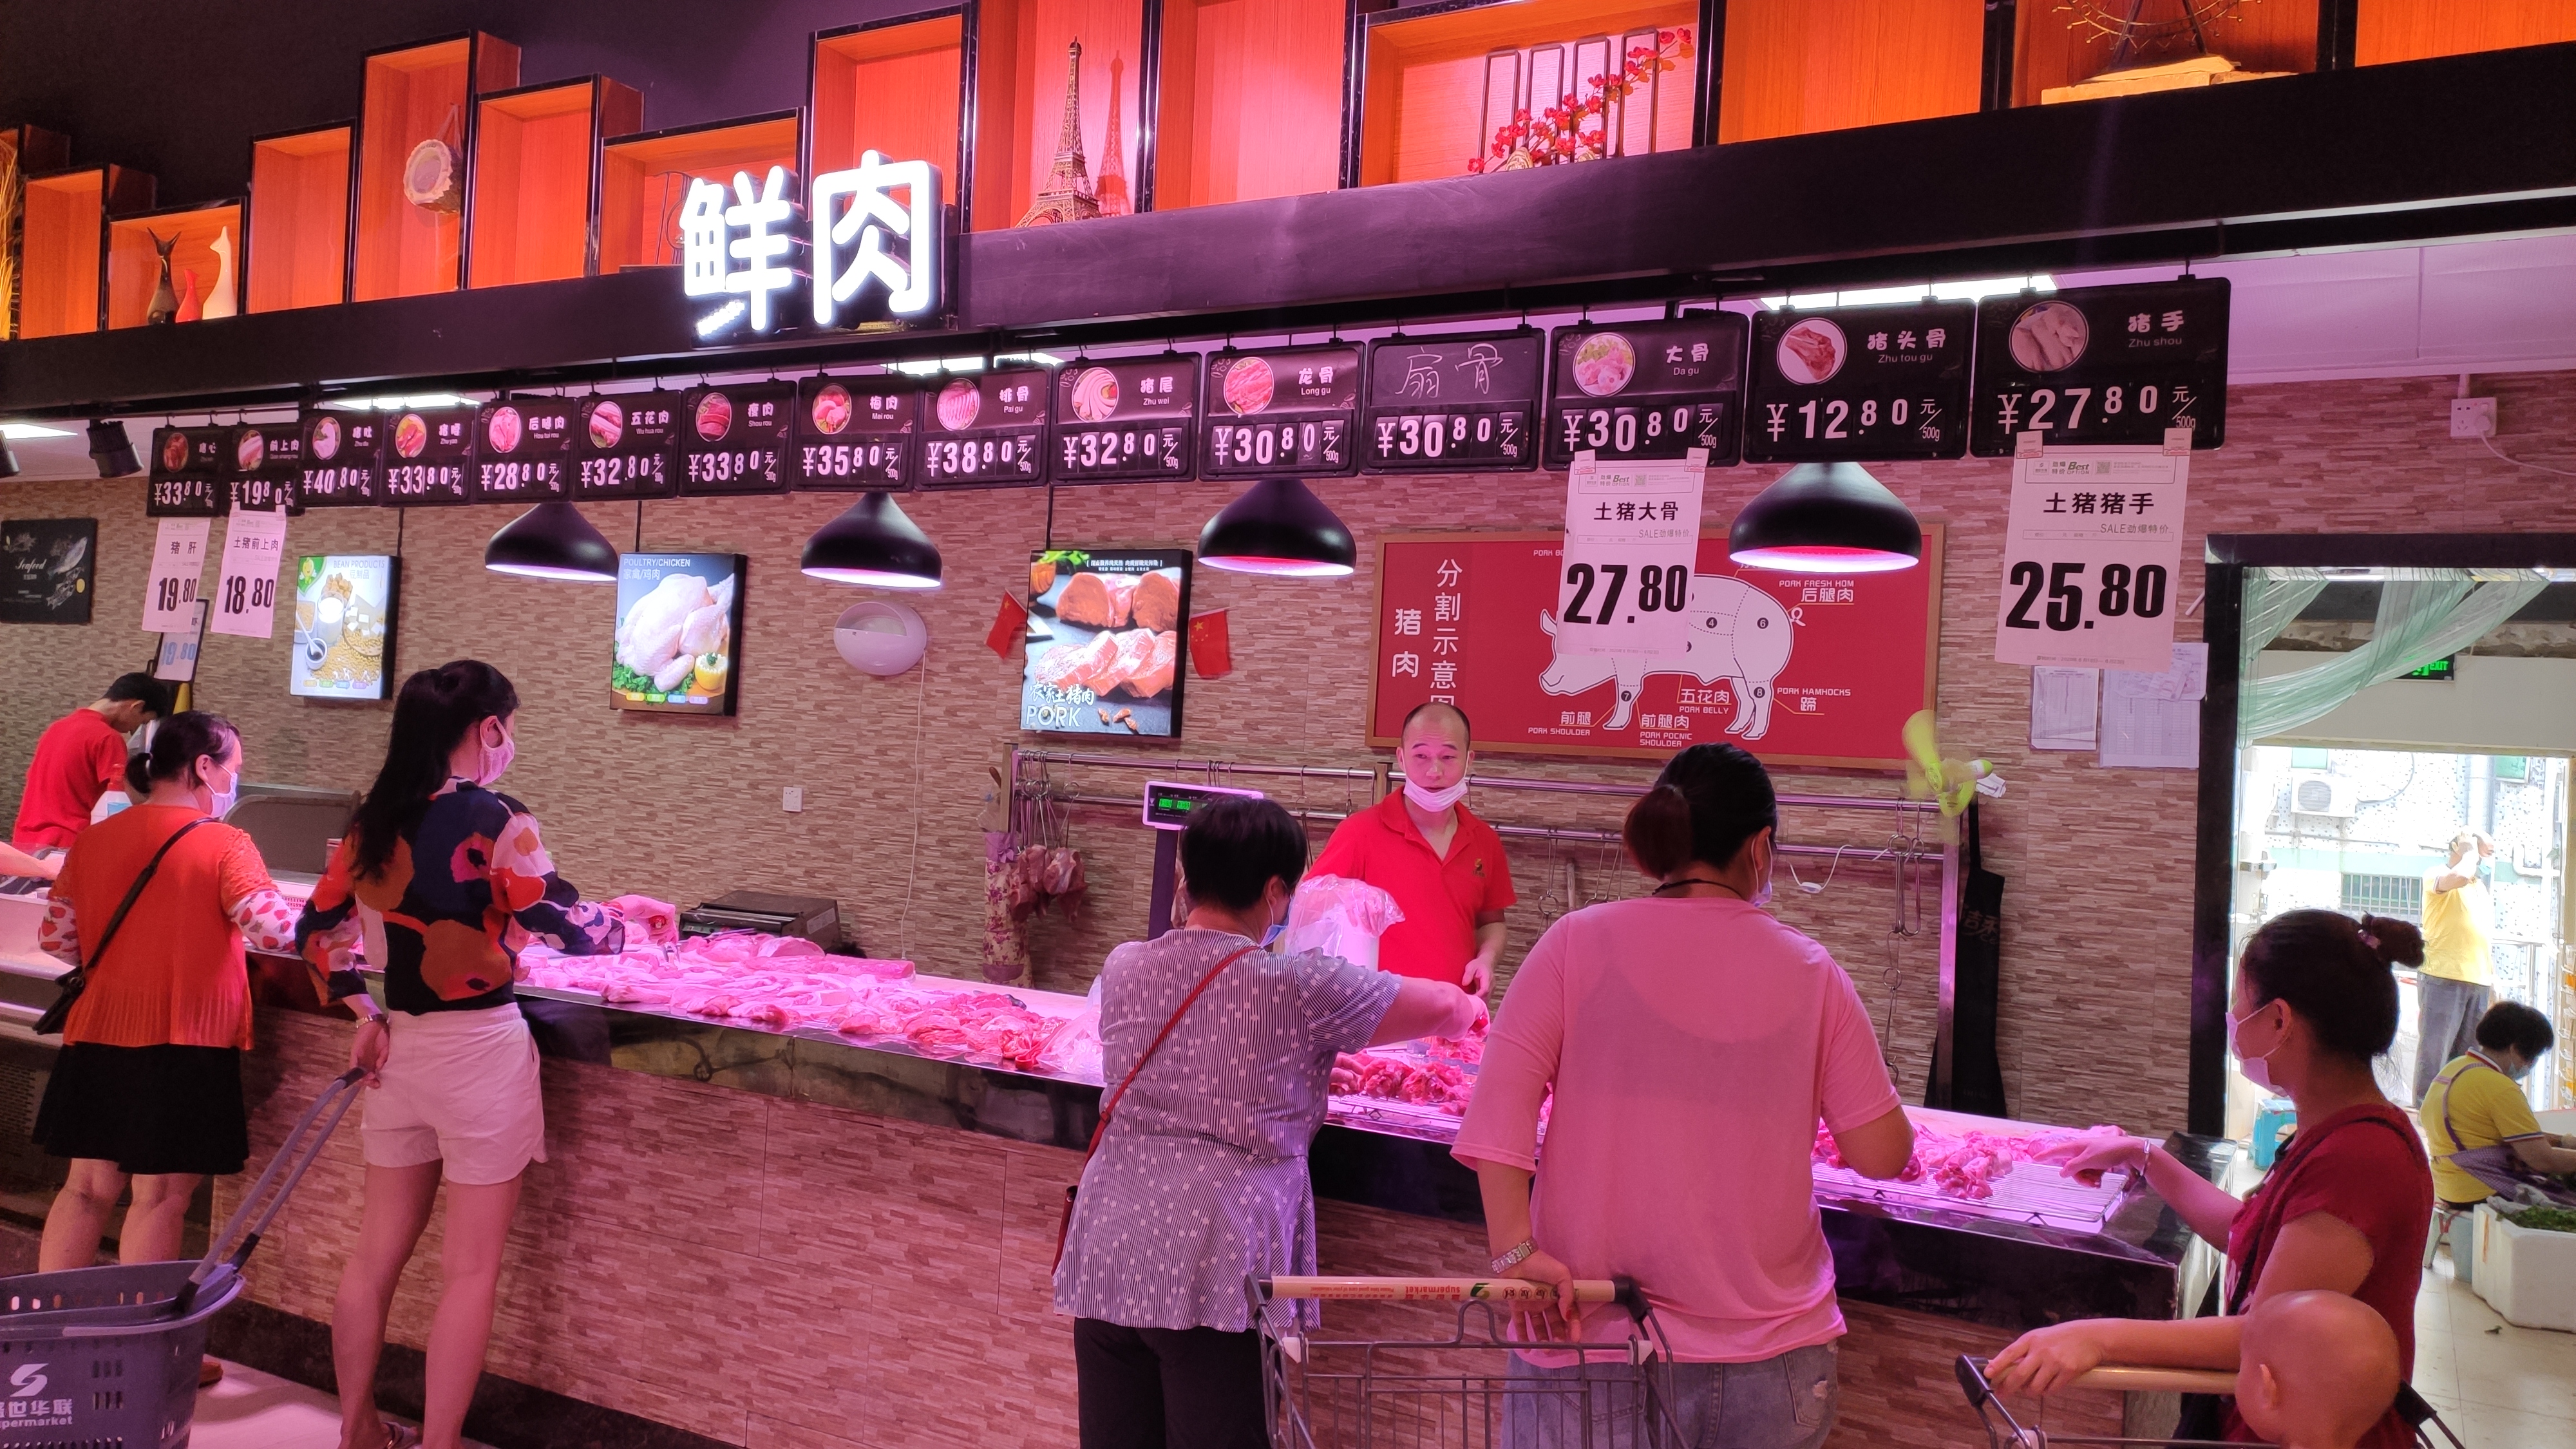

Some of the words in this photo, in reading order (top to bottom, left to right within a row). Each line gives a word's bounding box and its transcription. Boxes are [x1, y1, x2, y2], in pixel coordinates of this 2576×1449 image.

[679, 149, 938, 336] 鲜肉
[2128, 310, 2184, 332] 猪手
[1868, 328, 1946, 351] 猪头骨
[2128, 338, 2150, 348] Zhu
[2154, 337, 2183, 346] shou
[1666, 343, 1709, 364] 大骨
[1878, 354, 1898, 364] Zhu
[1900, 354, 1917, 363] tou
[1920, 355, 1933, 365] gu
[1298, 366, 1333, 384] 龙骨
[1395, 343, 1504, 399] 扇骨
[1673, 367, 1687, 376] Da
[1689, 368, 1700, 377] gu
[999, 386, 1029, 403] 排骨
[1140, 377, 1173, 394] 猪尾
[1301, 388, 1320, 397] Long
[748, 402, 773, 418] 瘦肉
[870, 395, 898, 411] 梅肉
[1143, 397, 1157, 406] Zhu
[1157, 397, 1170, 405] wei
[1998, 386, 2157, 435] ¥27.80
[631, 410, 669, 426] 五花肉
[1766, 399, 1908, 441] ¥12.80
[1378, 416, 1490, 457] ¥30.80
[1564, 408, 1689, 451] ¥30.80
[1063, 432, 1156, 469] ¥32.80
[1215, 422, 1316, 466] ¥30.80
[688, 450, 759, 483] ¥33.80
[803, 446, 879, 477] ¥35.80
[927, 440, 1012, 477] ¥38.80
[2068, 461, 2089, 470] Best
[303, 467, 357, 495] ¥40.80
[388, 466, 448, 495] ¥33.80
[481, 462, 545, 491] ¥28.80
[581, 455, 649, 488] ¥32.80
[154, 480, 202, 506] ¥33.80
[2043, 492, 2154, 515] 土猪猪手
[1593, 501, 1678, 521] 土猪大骨
[171, 541, 197, 554] 猪肝
[233, 536, 278, 551] 土猪前上肉
[351, 560, 385, 569] PRODUCTS
[623, 558, 691, 567] POULTRY/CHICKEN
[158, 577, 197, 612] 19.80
[224, 575, 274, 614] 18.80
[1563, 563, 1688, 625] 27.80
[1801, 588, 1853, 602] 后腿肉
[2005, 561, 2167, 632] 25.80
[1392, 609, 1421, 677] 猪肉
[1029, 681, 1095, 706] 农家土猪肉
[1680, 688, 1730, 704] 五花肉
[1801, 697, 1817, 711] 蹄
[1026, 705, 1082, 727] PORK
[1561, 711, 1591, 725] 前腿
[1642, 714, 1689, 728] 前腿肉
[1406, 1285, 1460, 1294] supermarket
[0, 1399, 73, 1418] 世华联
[0, 1416, 73, 1430] permarket
